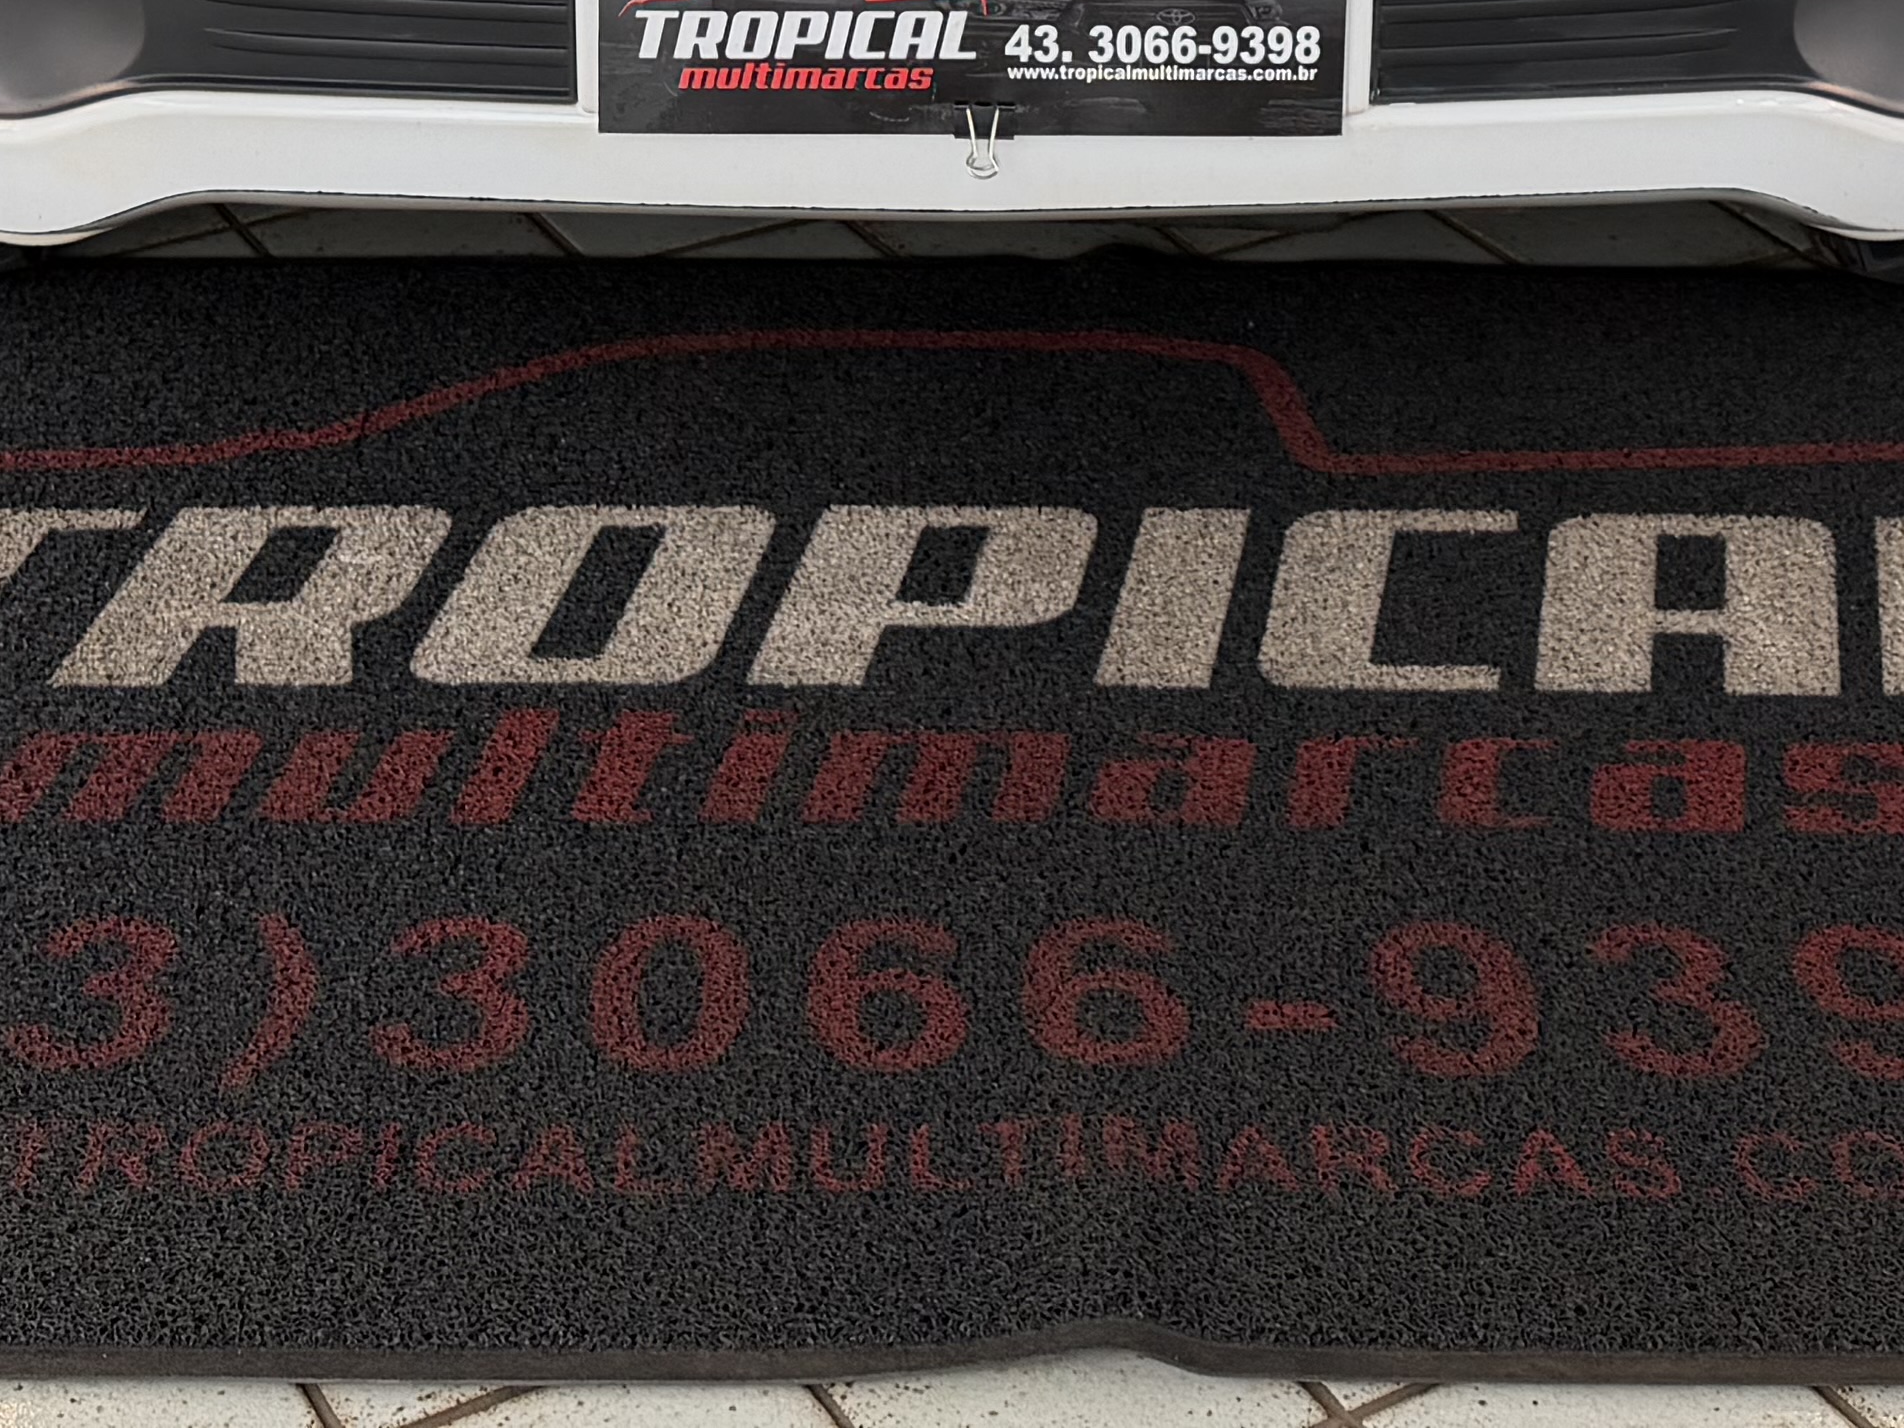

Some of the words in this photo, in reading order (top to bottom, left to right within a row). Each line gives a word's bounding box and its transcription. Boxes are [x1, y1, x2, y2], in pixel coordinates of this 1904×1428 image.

[635, 9, 977, 62] TROPICAL
[1004, 24, 1073, 63] 43.
[1087, 25, 1321, 64] 3066-9398
[677, 61, 934, 91] multimarcas
[1007, 64, 1318, 84] www.tropicalmultimarcas.com.br
